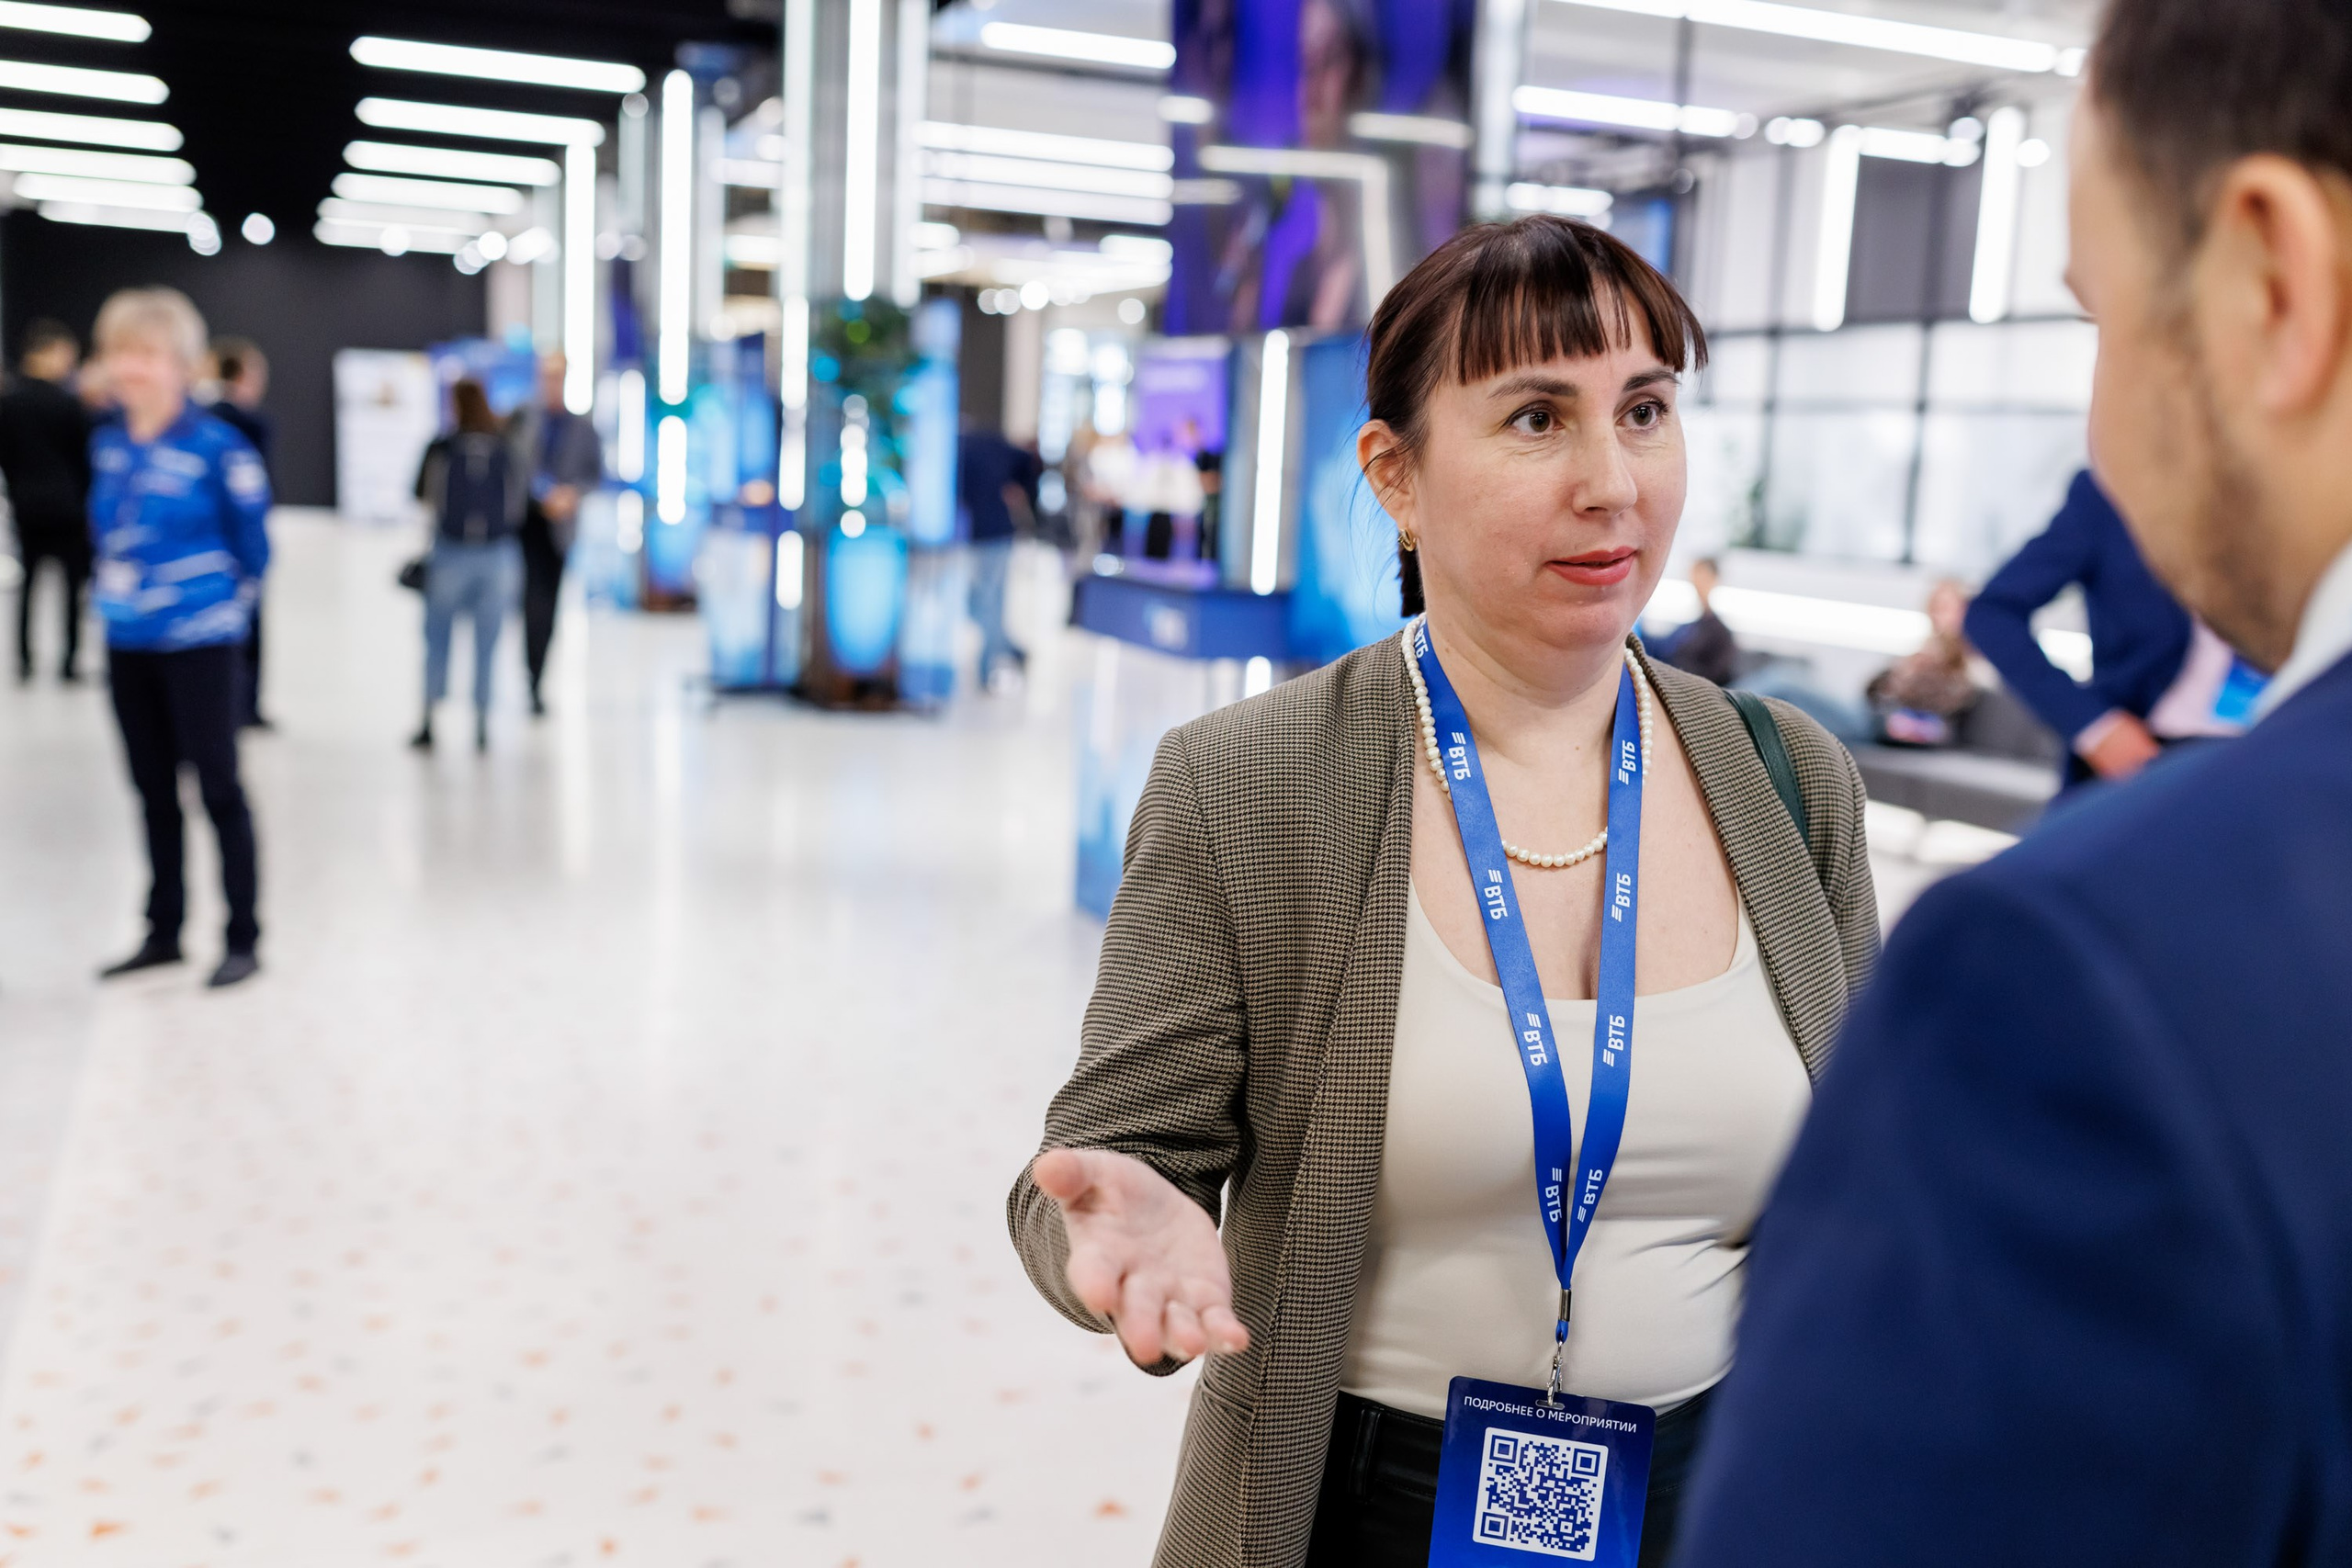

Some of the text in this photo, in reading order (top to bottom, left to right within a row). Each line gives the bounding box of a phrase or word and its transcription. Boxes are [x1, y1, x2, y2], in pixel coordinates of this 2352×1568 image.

[1415, 626, 1429, 659] ВТБ
[1448, 746, 1471, 781] ВТБ
[1621, 740, 1636, 773] ВТБ
[1484, 885, 1509, 919] ВТБ
[1615, 873, 1632, 908] ВТБ
[1523, 1030, 1547, 1066] ВТБ
[1608, 1014, 1625, 1051] ВТБ
[1545, 1184, 1562, 1223] ВТБ
[1583, 1168, 1603, 1205] ВТБ
[1464, 1395, 1637, 1433] ПОДРОБНЕЕ О МЕРОПРИЯТИИ
